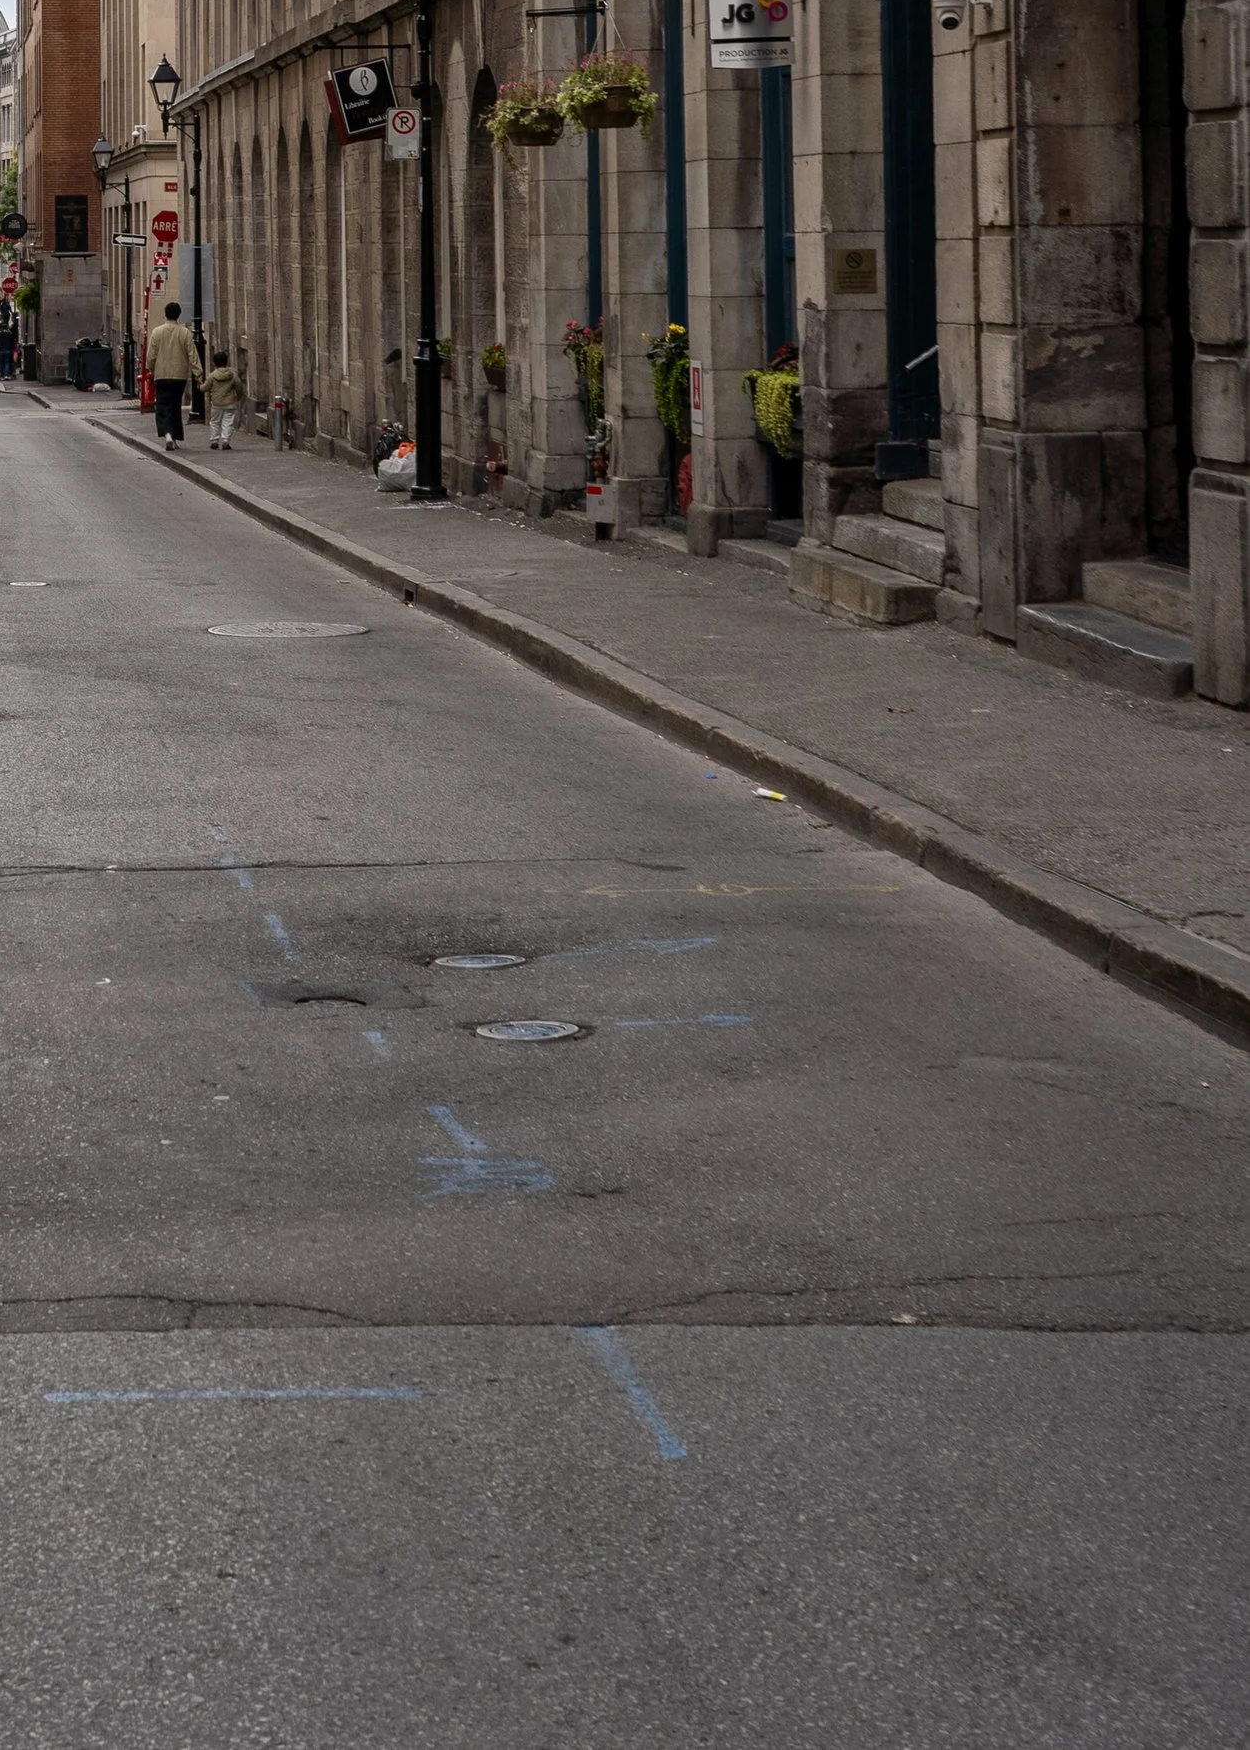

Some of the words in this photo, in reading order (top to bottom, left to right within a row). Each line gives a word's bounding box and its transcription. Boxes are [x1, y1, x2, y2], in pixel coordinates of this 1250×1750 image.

[721, 3, 755, 23] JG
[718, 49, 777, 58] PRODUCTION
[153, 221, 177, 231] ARRÊ
